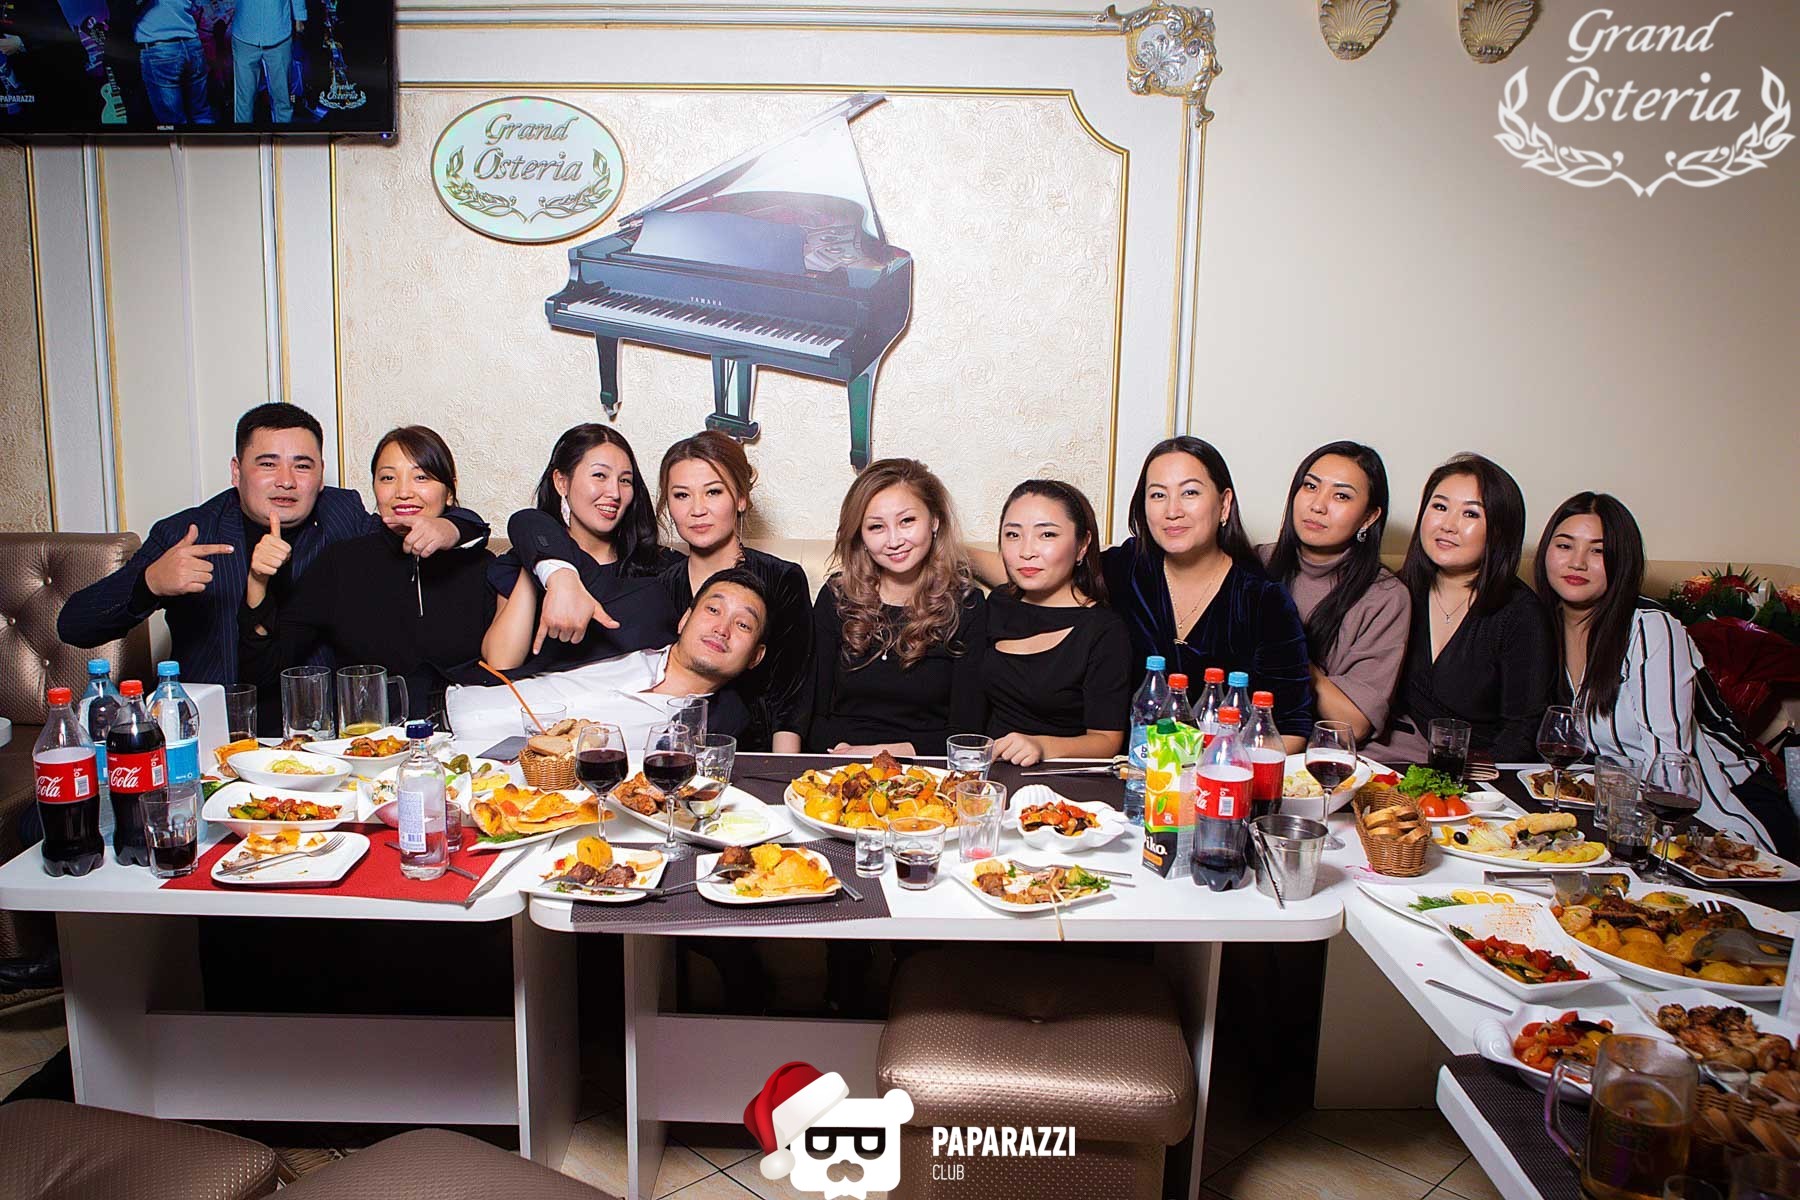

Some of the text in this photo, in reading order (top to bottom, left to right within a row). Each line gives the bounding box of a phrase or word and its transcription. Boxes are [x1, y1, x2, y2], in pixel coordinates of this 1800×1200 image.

[485, 113, 579, 145] Grand
[474, 147, 583, 181] Osteria
[690, 296, 722, 306] YAMAHA
[110, 766, 142, 788] Cola
